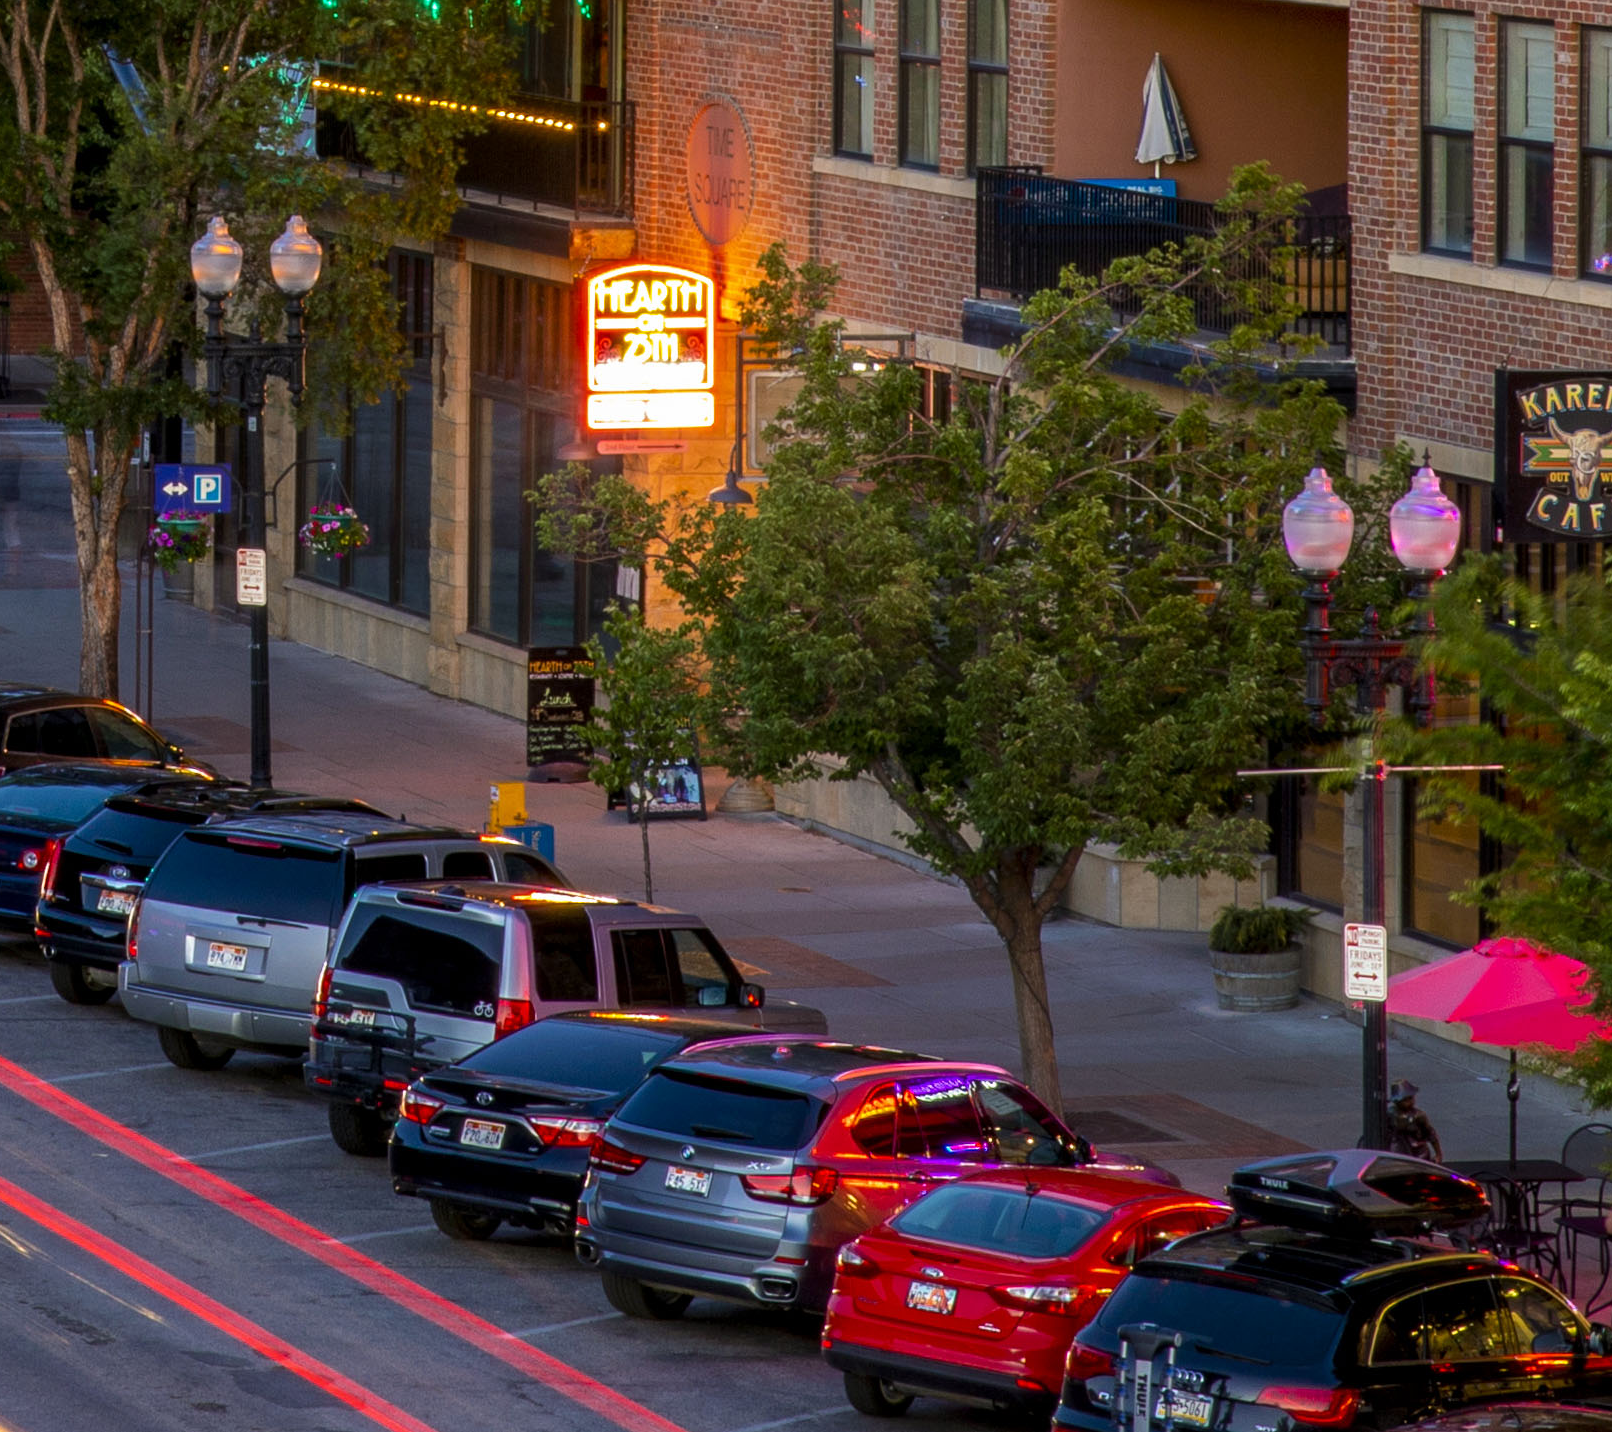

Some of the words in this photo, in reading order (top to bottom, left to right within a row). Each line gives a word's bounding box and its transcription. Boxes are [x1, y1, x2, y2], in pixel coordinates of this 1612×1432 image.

[706, 125, 734, 158] TIME
[695, 173, 745, 211] SQUARE
[595, 279, 702, 313] HEARTH
[623, 332, 679, 363] 25TH
[1549, 472, 1570, 482] OUT
[200, 478, 217, 500] P
[529, 661, 563, 674] HEARTH
[540, 687, 574, 708] Lunch
[1350, 950, 1382, 962] FRIDAYS
[1260, 1176, 1289, 1190] THULE
[1135, 1373, 1148, 1420] THULE
